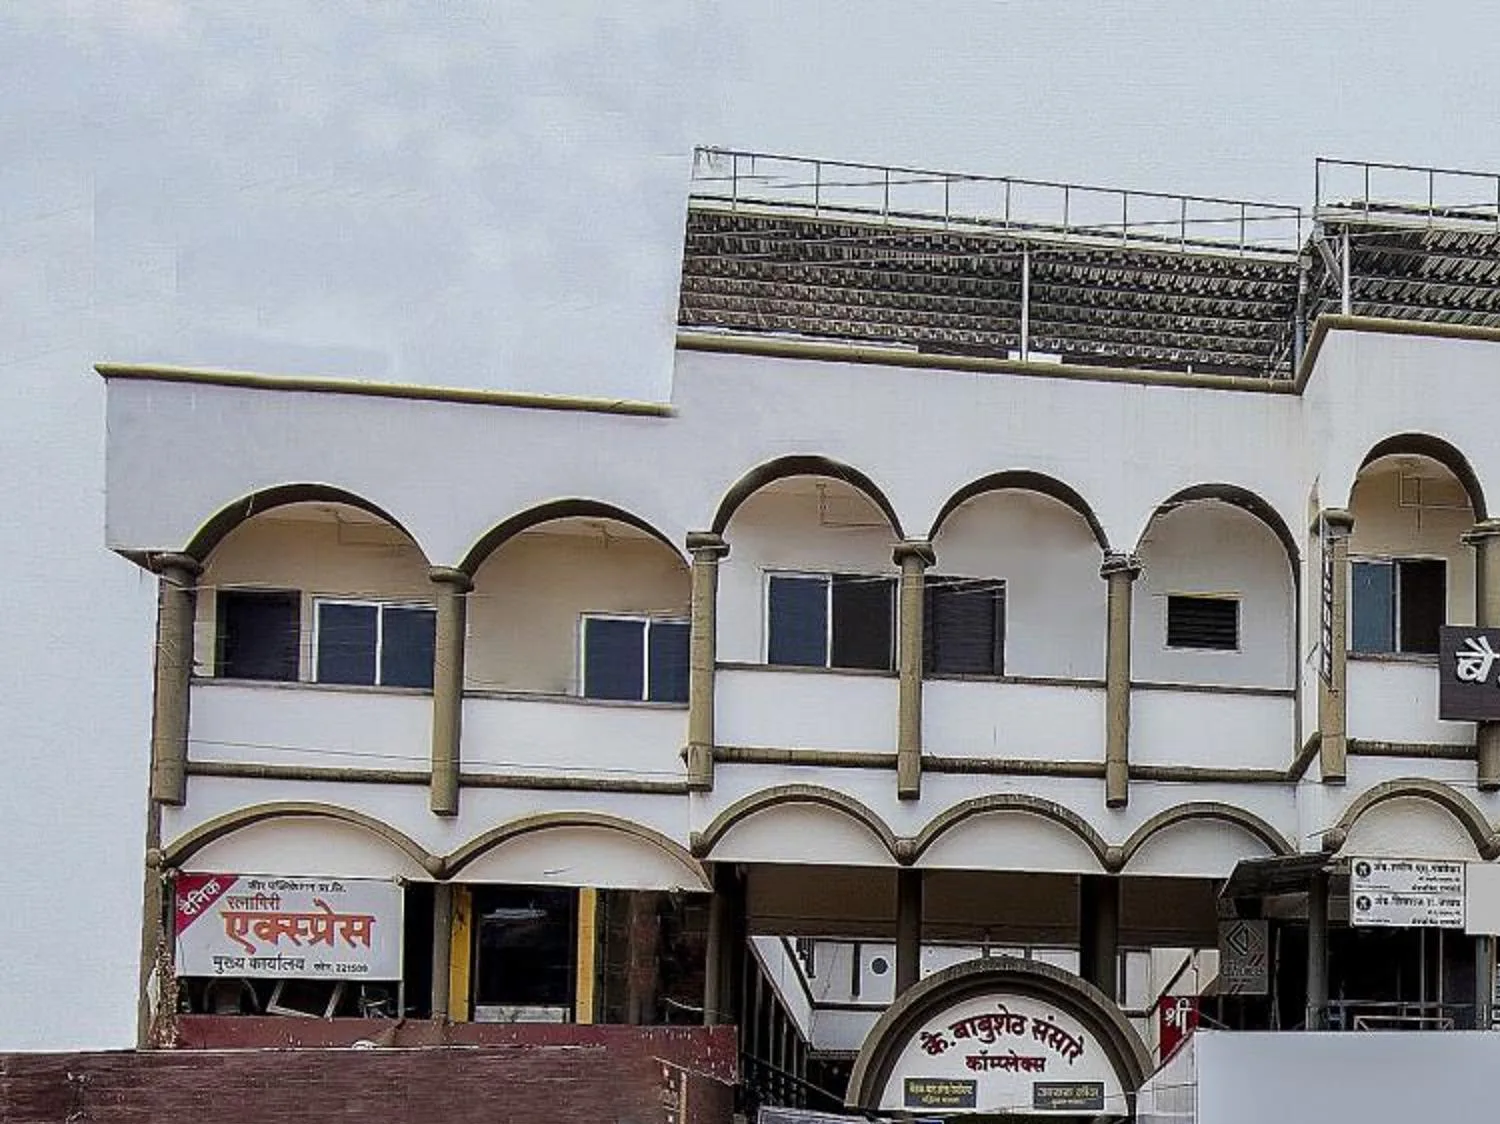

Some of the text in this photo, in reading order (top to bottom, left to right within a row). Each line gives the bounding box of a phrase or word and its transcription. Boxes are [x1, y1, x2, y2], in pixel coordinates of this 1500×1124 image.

[179, 879, 221, 916] दैनिक
[226, 894, 281, 911] रत्नागिरी
[220, 897, 376, 955] एक्स्प्रेस
[212, 952, 305, 974] मुख्य कार्यालय
[1032, 1015, 1085, 1065] संसारे
[965, 1049, 1047, 1072] कॉम्प्लेक्स
